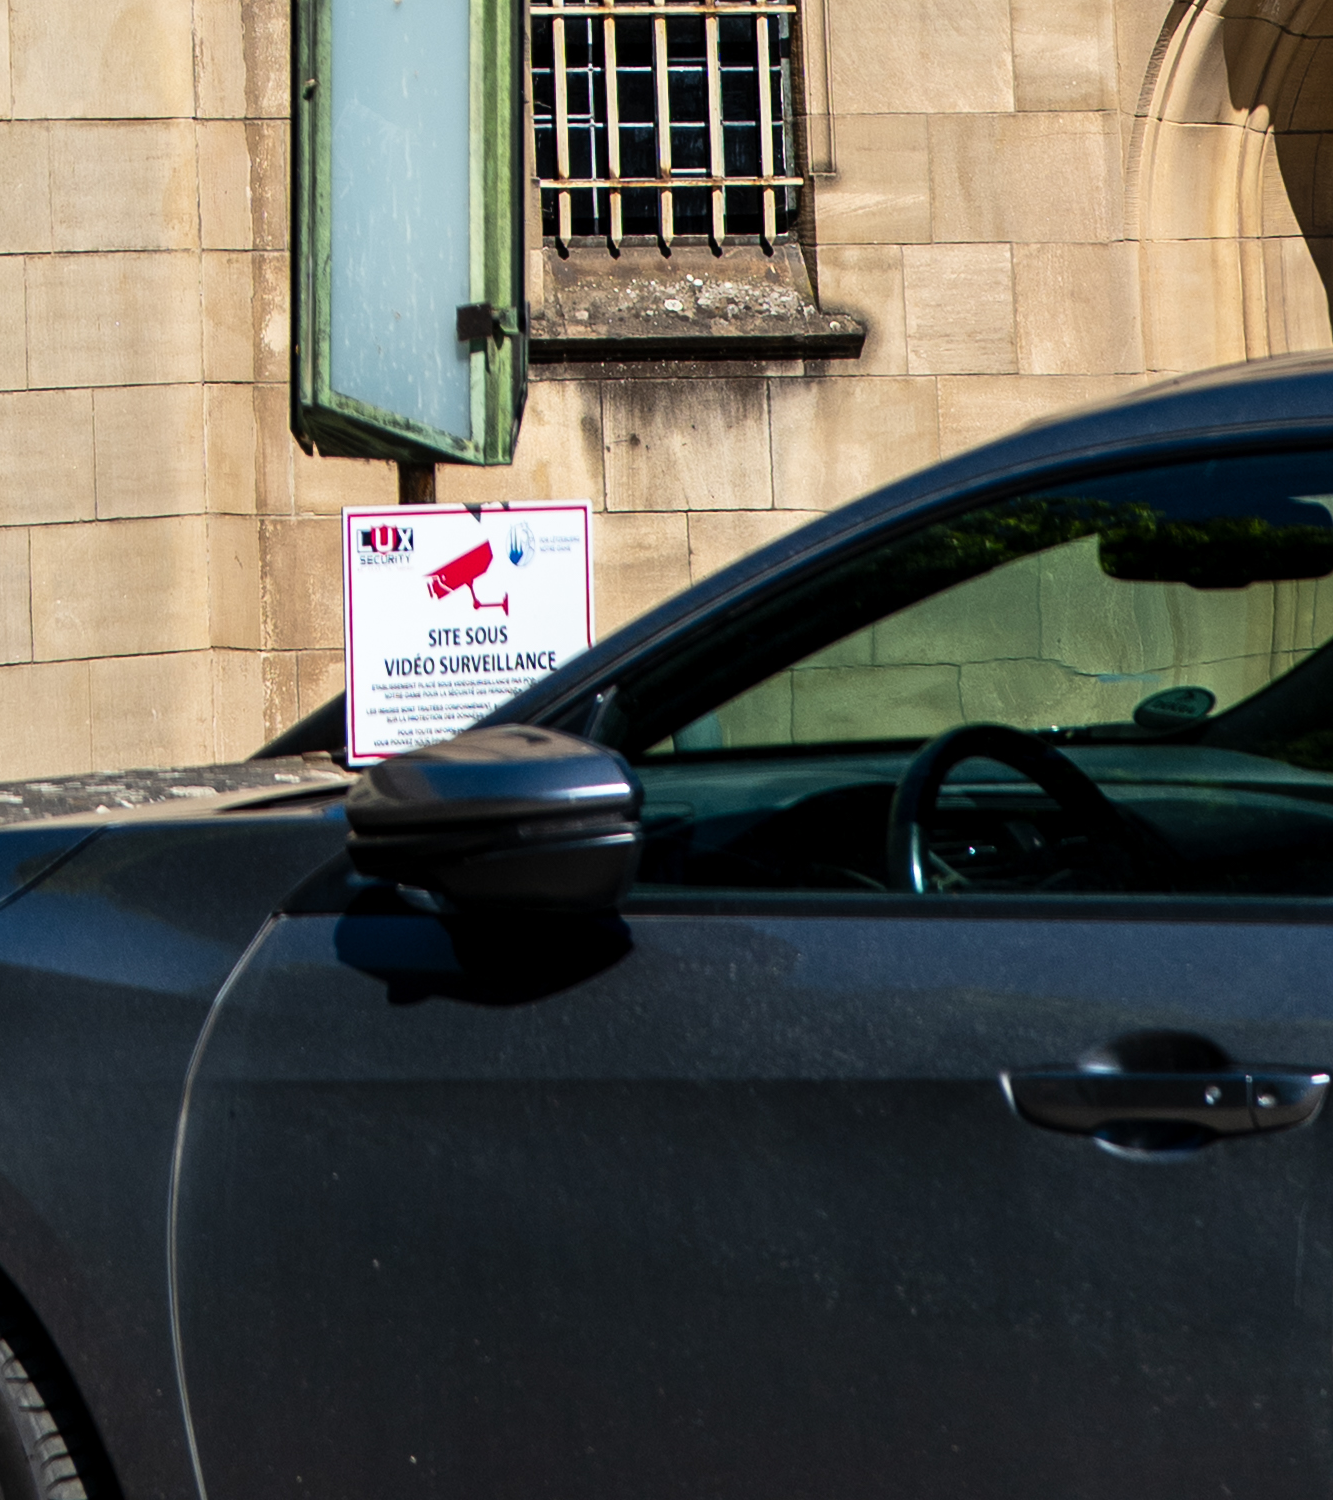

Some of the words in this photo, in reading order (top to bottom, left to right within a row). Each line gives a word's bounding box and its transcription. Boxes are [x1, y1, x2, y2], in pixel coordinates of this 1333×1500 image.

[357, 526, 413, 553] LUX
[428, 627, 461, 647] SITE
[465, 624, 508, 646] SOUS
[384, 653, 436, 677] VIDÉO
[439, 650, 558, 675] SURVEILLANCE
